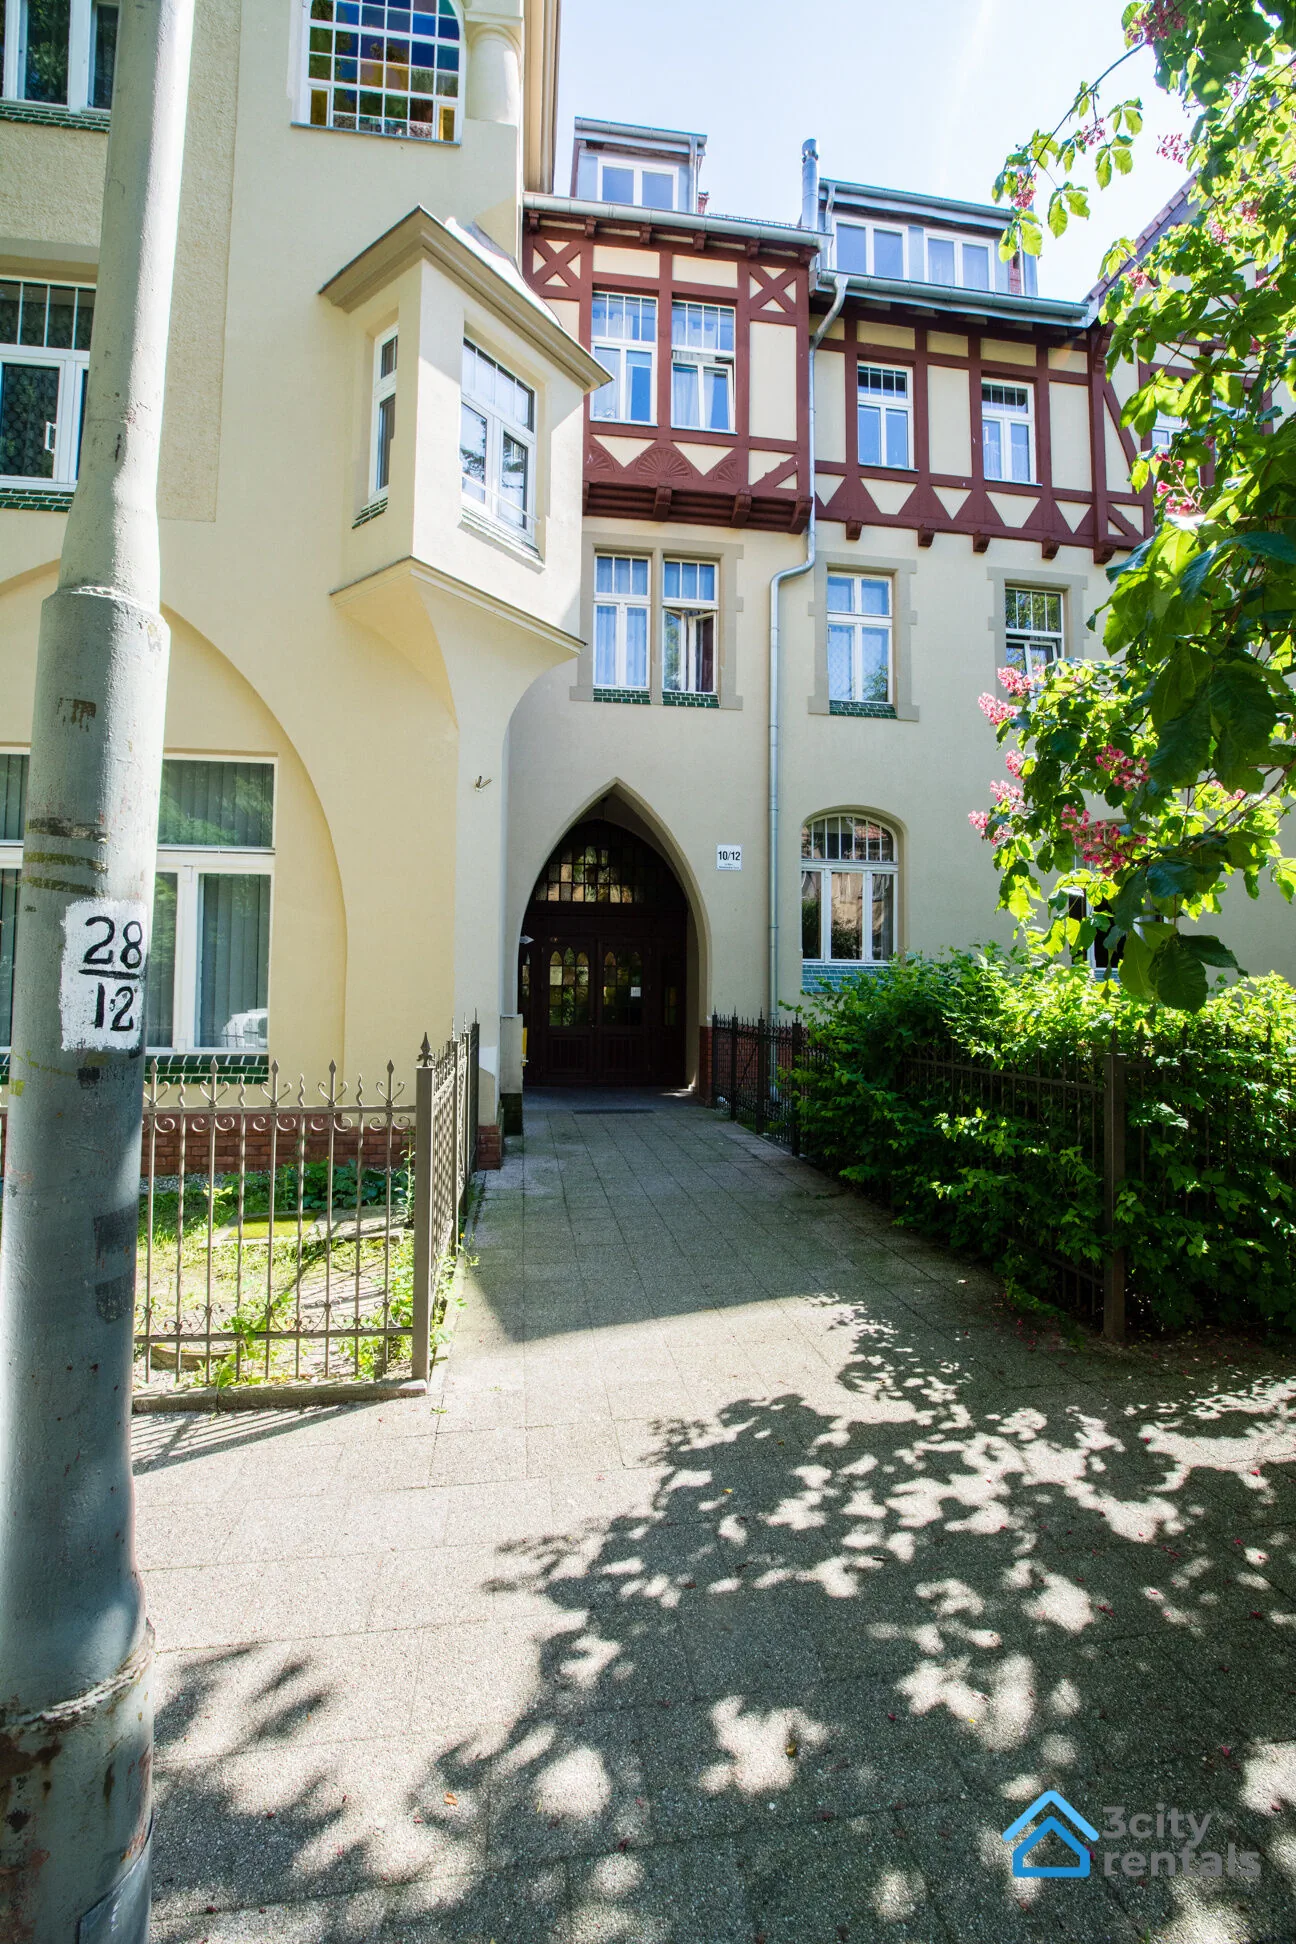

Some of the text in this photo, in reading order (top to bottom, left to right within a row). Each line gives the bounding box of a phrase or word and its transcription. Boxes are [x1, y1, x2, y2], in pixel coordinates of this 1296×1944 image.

[718, 850, 741, 861] 10/12
[83, 915, 143, 970] 28
[94, 982, 134, 1032] 12
